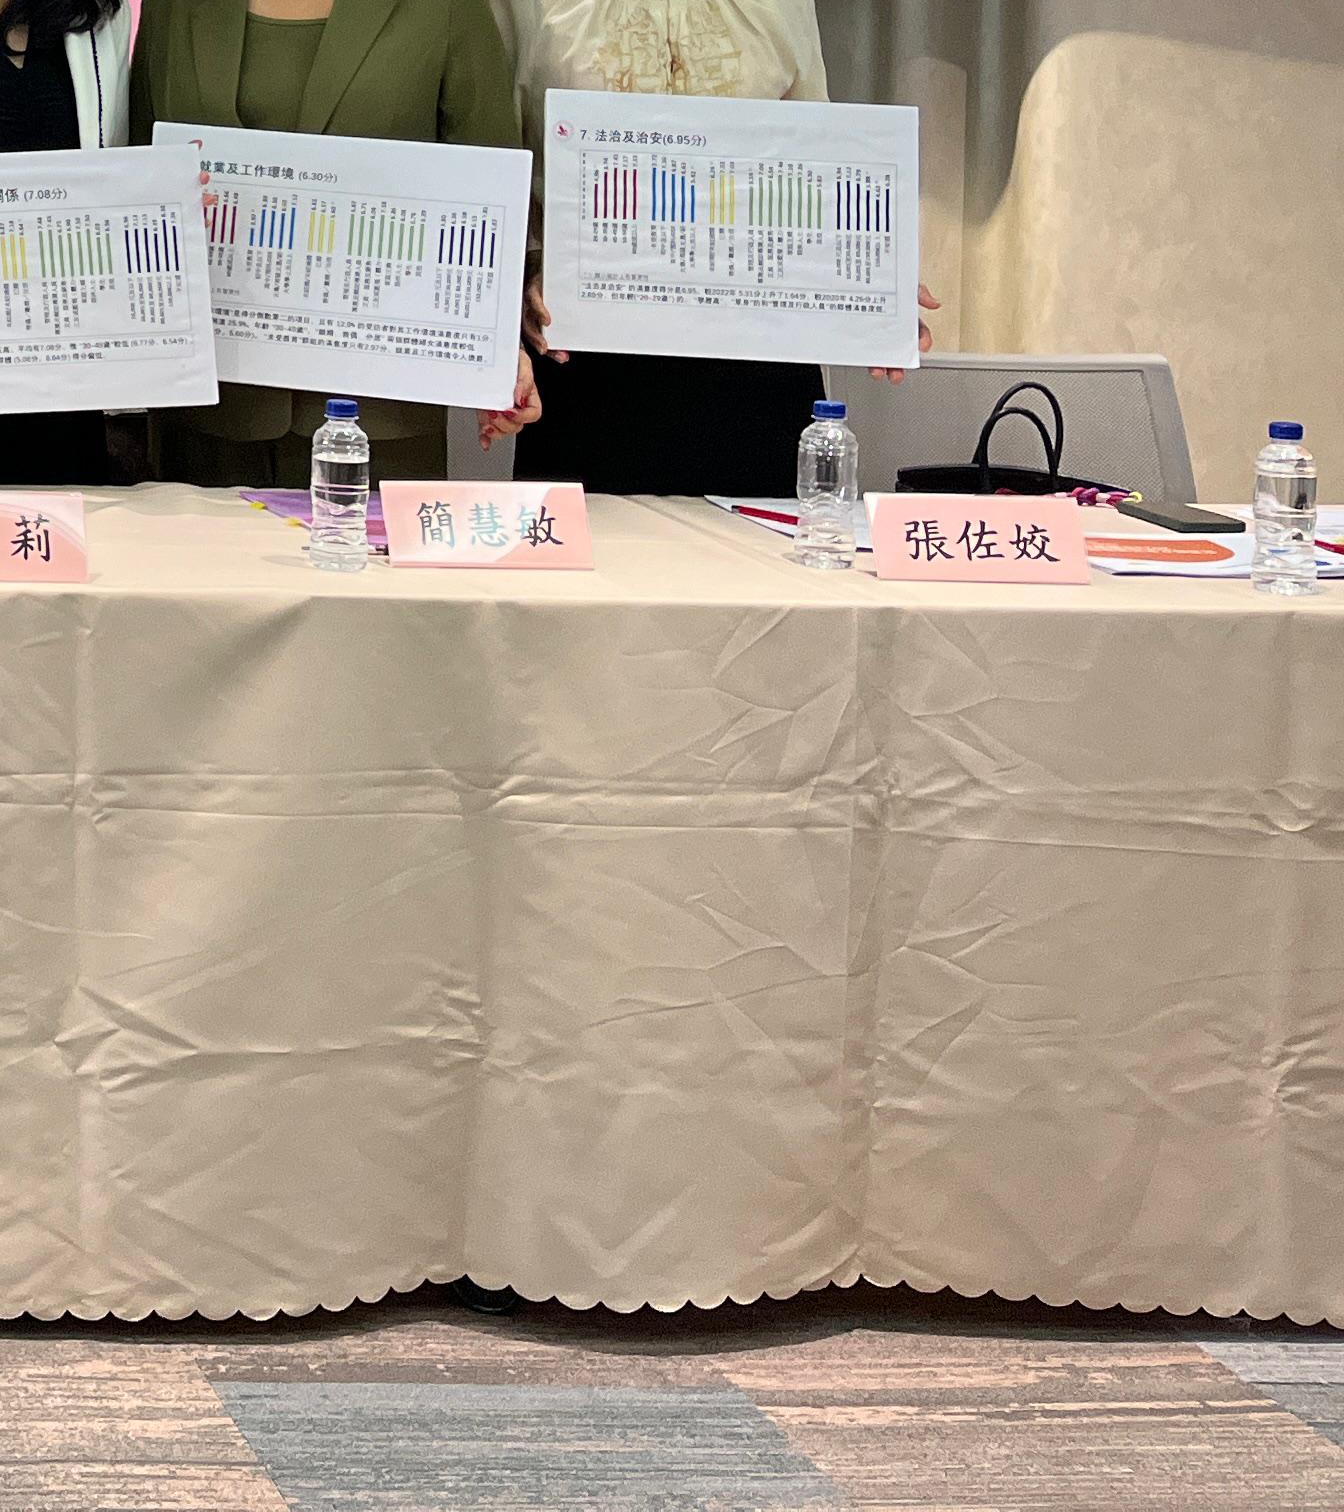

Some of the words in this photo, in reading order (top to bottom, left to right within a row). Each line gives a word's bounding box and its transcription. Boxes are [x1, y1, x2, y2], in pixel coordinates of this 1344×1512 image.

[24, 188, 68, 202] (7.08分)
[416, 500, 564, 549] 簡慧敏
[905, 520, 1061, 564] 張佐姣
